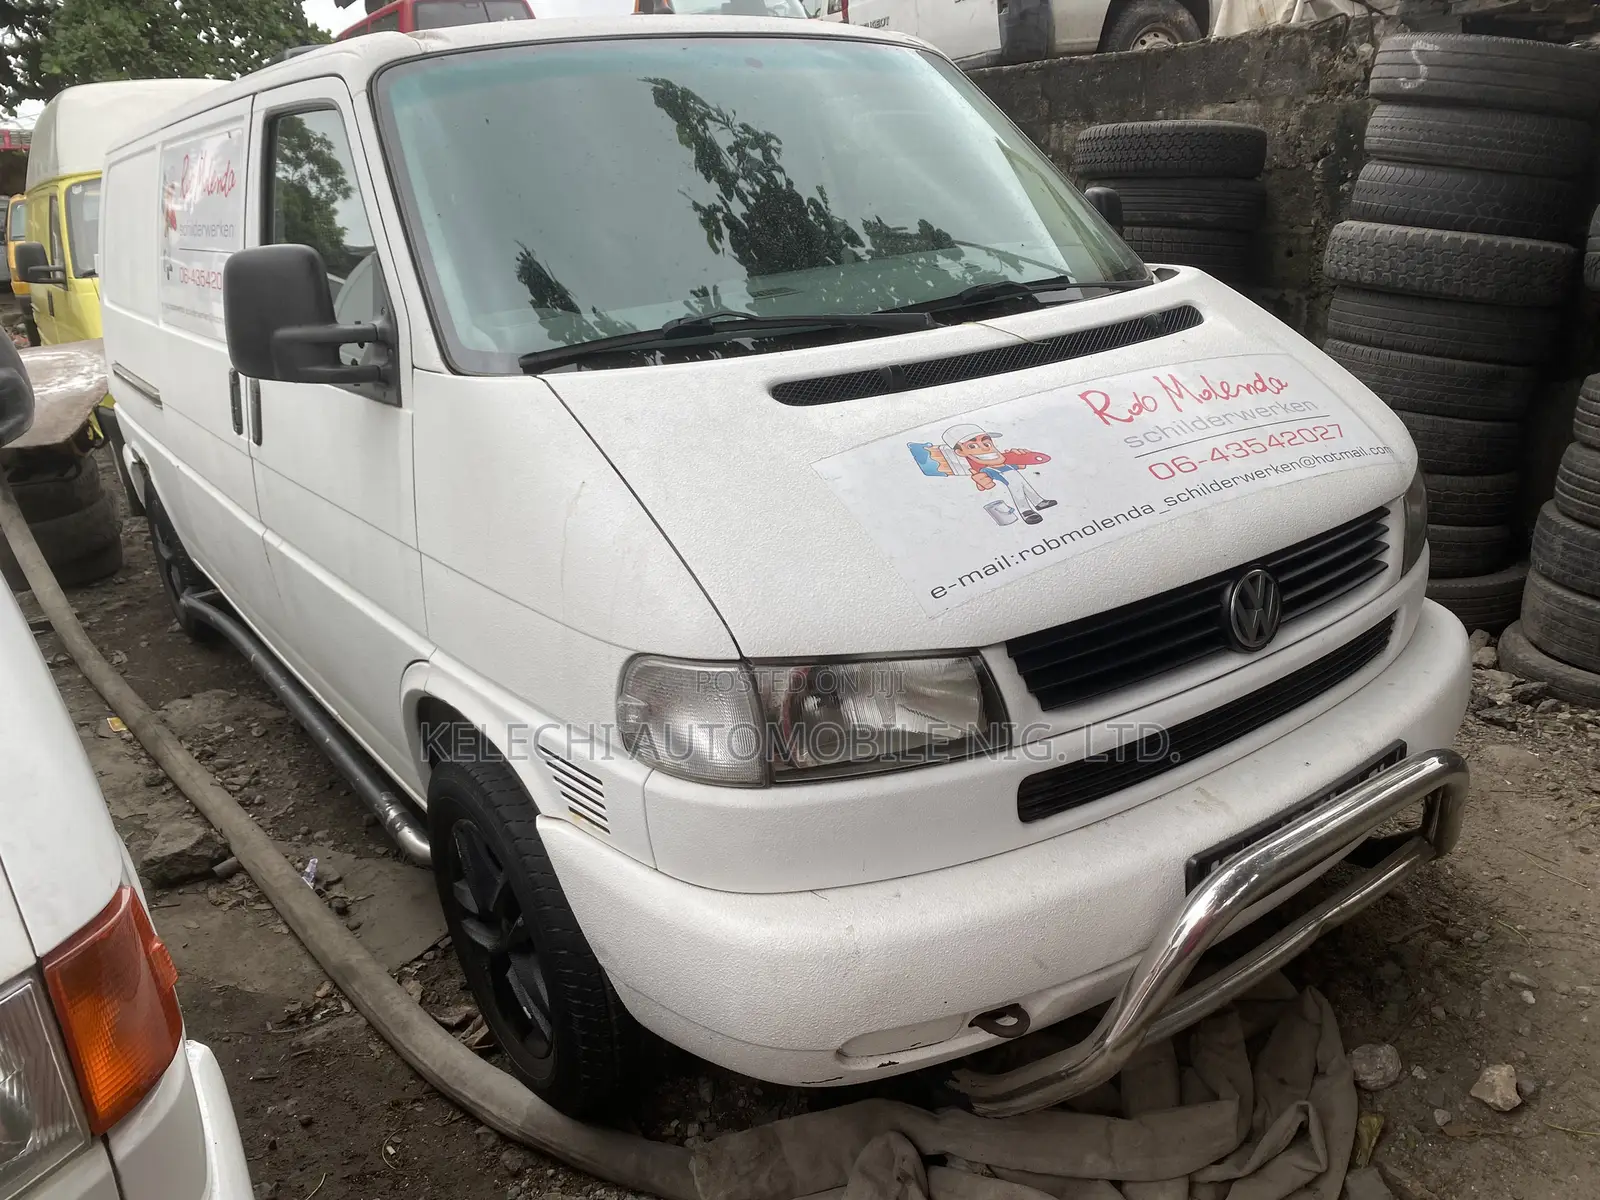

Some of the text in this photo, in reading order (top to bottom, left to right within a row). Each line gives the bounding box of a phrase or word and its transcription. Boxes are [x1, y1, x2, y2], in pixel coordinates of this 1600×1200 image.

[179, 266, 223, 290] 06-435420
[1153, 371, 1288, 412] Molenda
[1123, 400, 1320, 448] schilderwerken
[1148, 423, 1343, 480] 06-43542027
